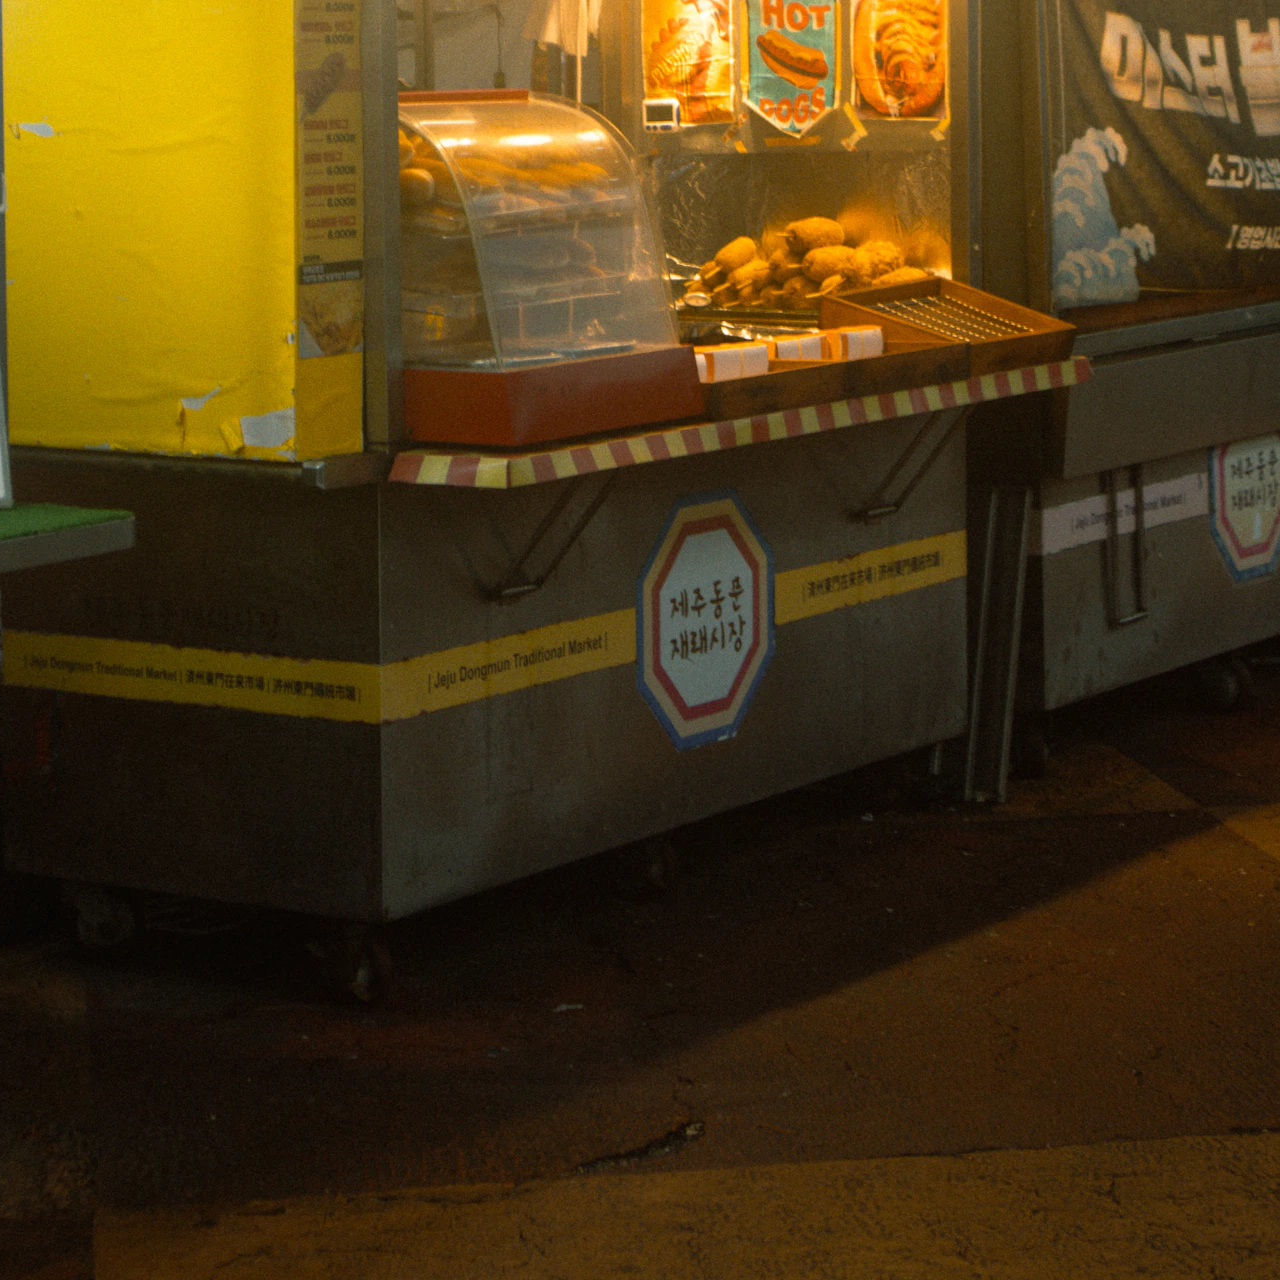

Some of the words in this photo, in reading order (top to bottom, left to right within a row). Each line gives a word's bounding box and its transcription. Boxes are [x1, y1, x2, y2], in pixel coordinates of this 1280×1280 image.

[759, 86, 825, 125] DOGS
[668, 575, 745, 621] 제주동문
[433, 664, 457, 690] Jeju
[459, 656, 511, 685] Dongmun
[513, 644, 566, 671] Traditional
[568, 633, 605, 658] Market
[669, 617, 746, 662] 재래시장
[96, 661, 144, 679] Traditional
[145, 666, 178, 682] Market
